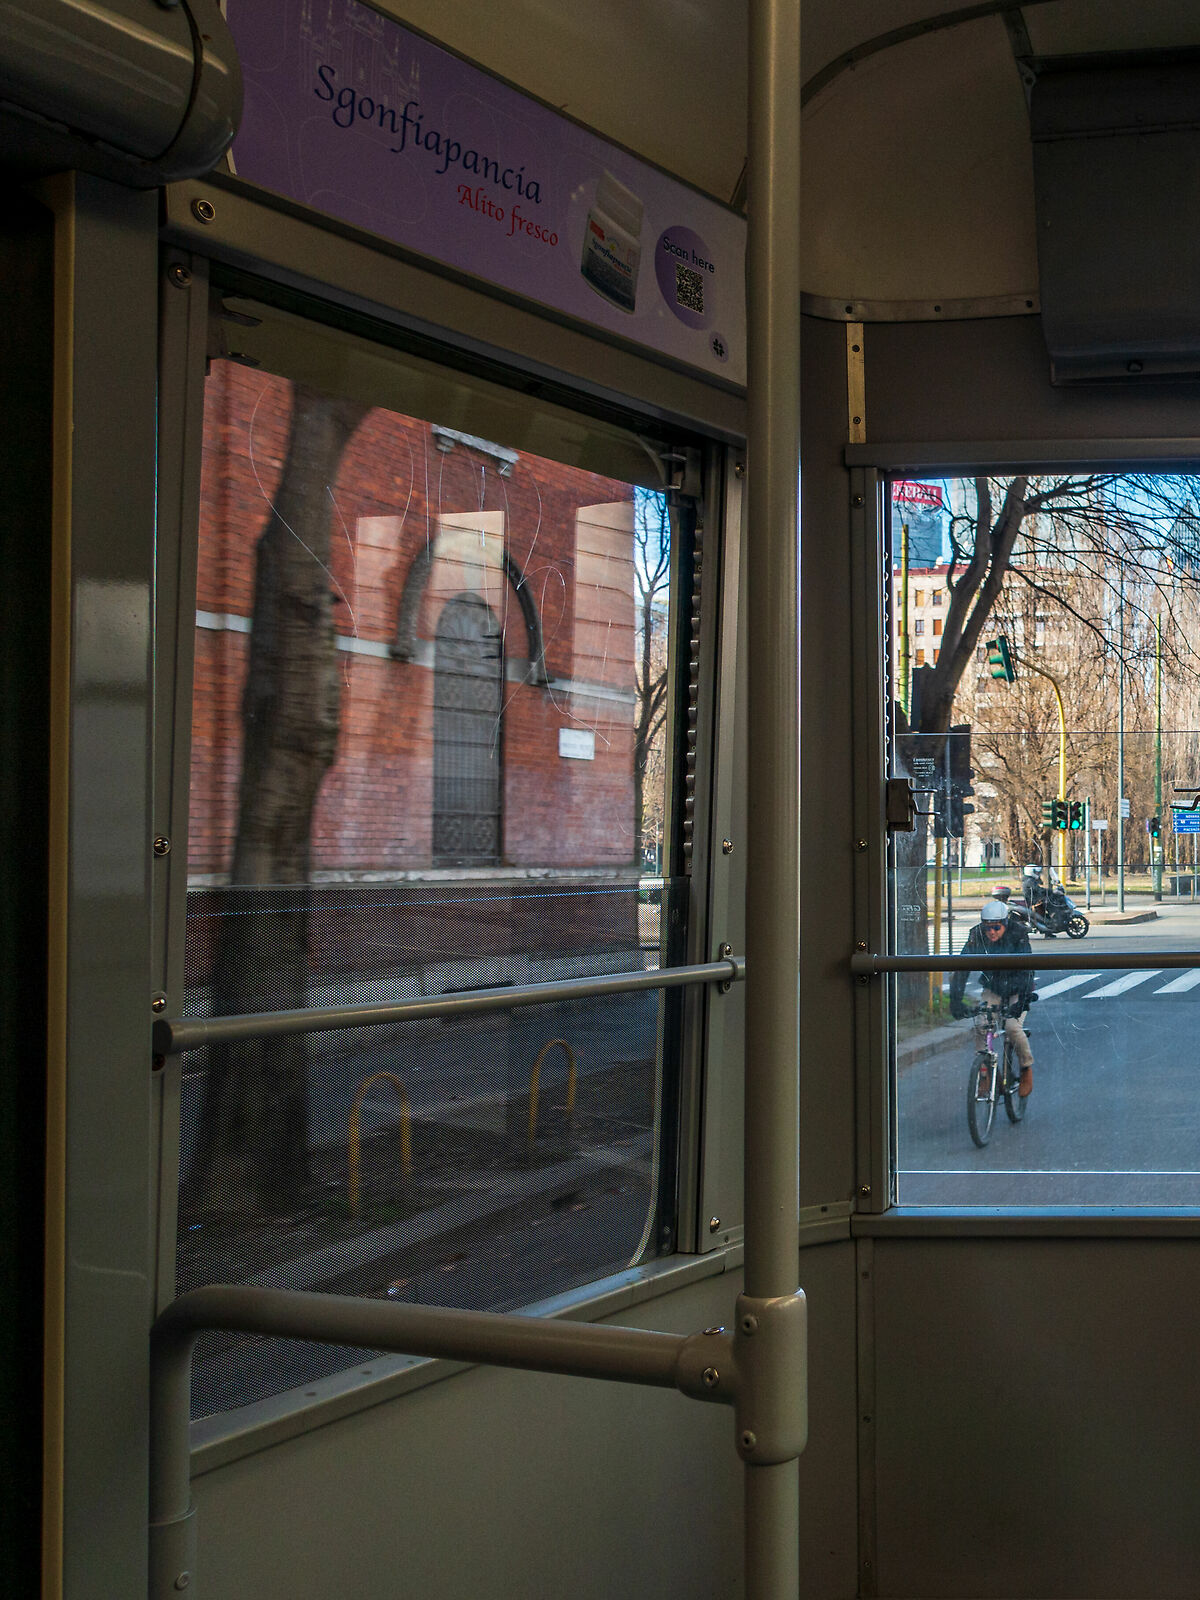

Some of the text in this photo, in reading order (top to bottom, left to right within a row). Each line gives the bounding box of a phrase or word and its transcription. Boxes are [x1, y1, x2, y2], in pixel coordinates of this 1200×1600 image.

[314, 65, 541, 204] Sgonfiapancia
[457, 184, 505, 221] Alito
[506, 205, 558, 246] fresco
[663, 236, 715, 273] Scan here
